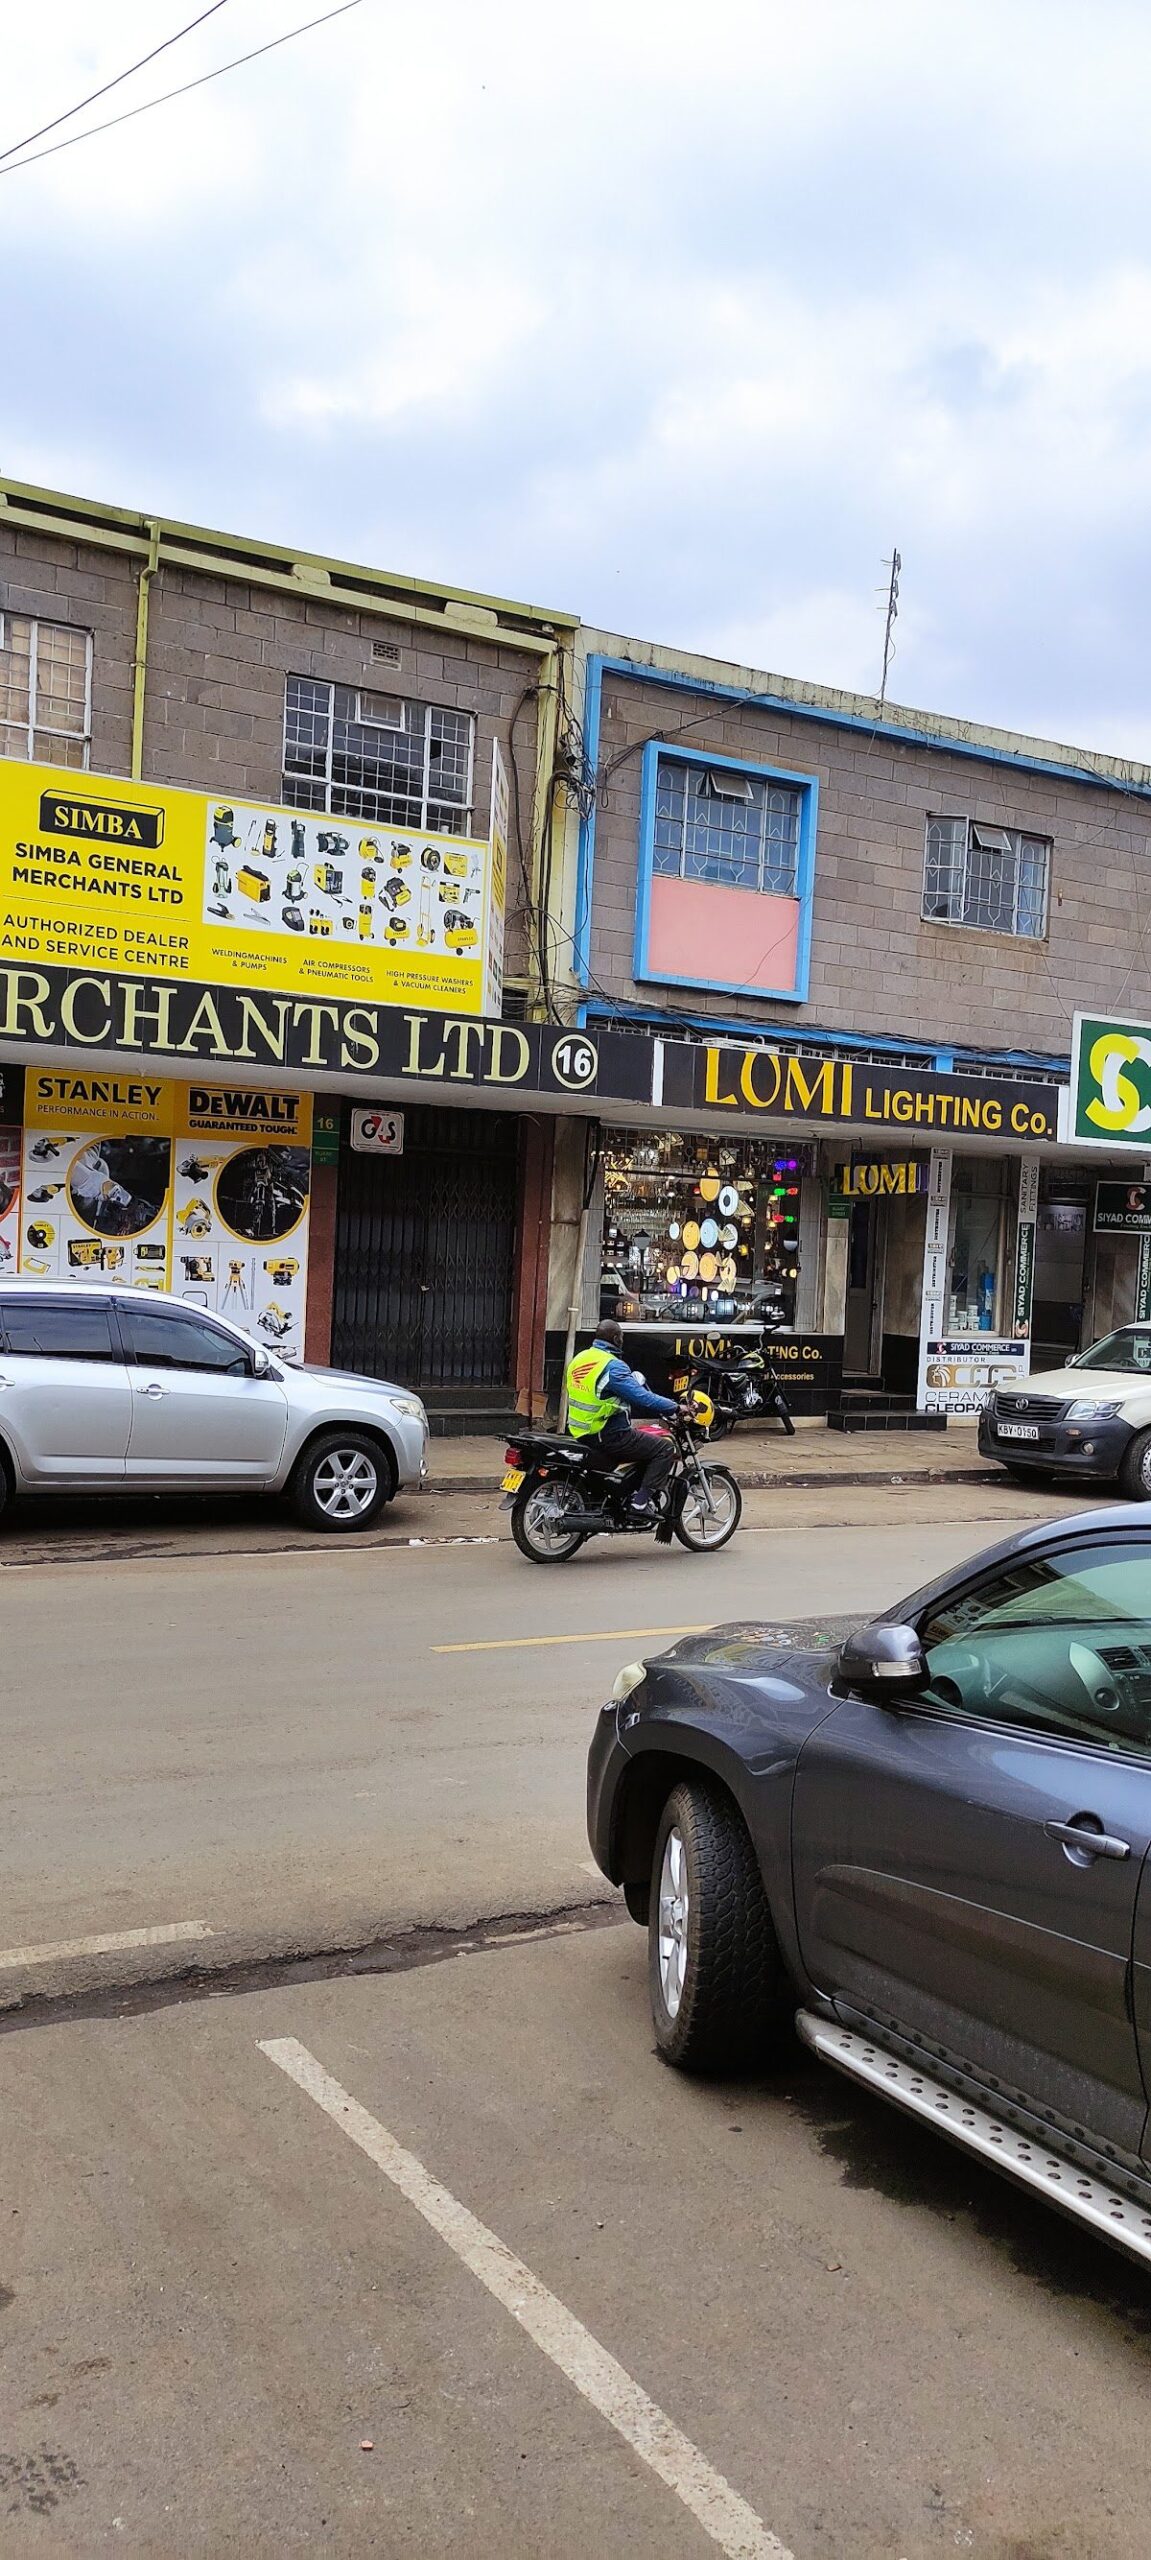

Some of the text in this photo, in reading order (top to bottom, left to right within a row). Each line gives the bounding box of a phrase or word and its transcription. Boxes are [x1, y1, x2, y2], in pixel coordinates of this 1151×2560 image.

[54, 805, 143, 840] SIMBA
[15, 842, 183, 882] SIMBA GENERAL
[12, 866, 184, 905] MERCHANTS LTD
[3, 913, 189, 950] AUTHORIZED DEALER
[1, 934, 189, 969] AND SERVICE CENTRE
[211, 948, 288, 964] WELDINGMACHINES
[240, 961, 267, 971] PUMPS
[303, 959, 371, 974] AIR COMPRESSORS
[307, 969, 349, 981] PNEUMATIC
[351, 975, 374, 983] TOOLS
[386, 970, 474, 987] HIGH PRESSURE WASHERS
[401, 981, 431, 991] VACUUM
[433, 984, 466, 995] CLEANERS
[0, 968, 592, 1083] RCHANTS LTD 16
[38, 1077, 162, 1106] STANLEY
[705, 1047, 1053, 1135] LOMI LIGHTING Co.
[37, 1104, 107, 1118] PERFORMANCE
[109, 1110, 119, 1118] IN
[318, 1117, 334, 1130] 16
[189, 1120, 258, 1132] GUARANTEED
[361, 1116, 396, 1145] G4S
[843, 1161, 918, 1196] LOMI
[1020, 1163, 1029, 1214] SANITARY
[1029, 1166, 1038, 1212] FITTINGS
[1098, 1213, 1123, 1223] SIYAD
[1017, 1223, 1030, 1317] SIYAD COMMERCE
[1138, 1289, 1147, 1319] SIYAD
[802, 1346, 823, 1360] Co.
[950, 1343, 970, 1351] SIYAD
[971, 1344, 1010, 1352] COMMERCE
